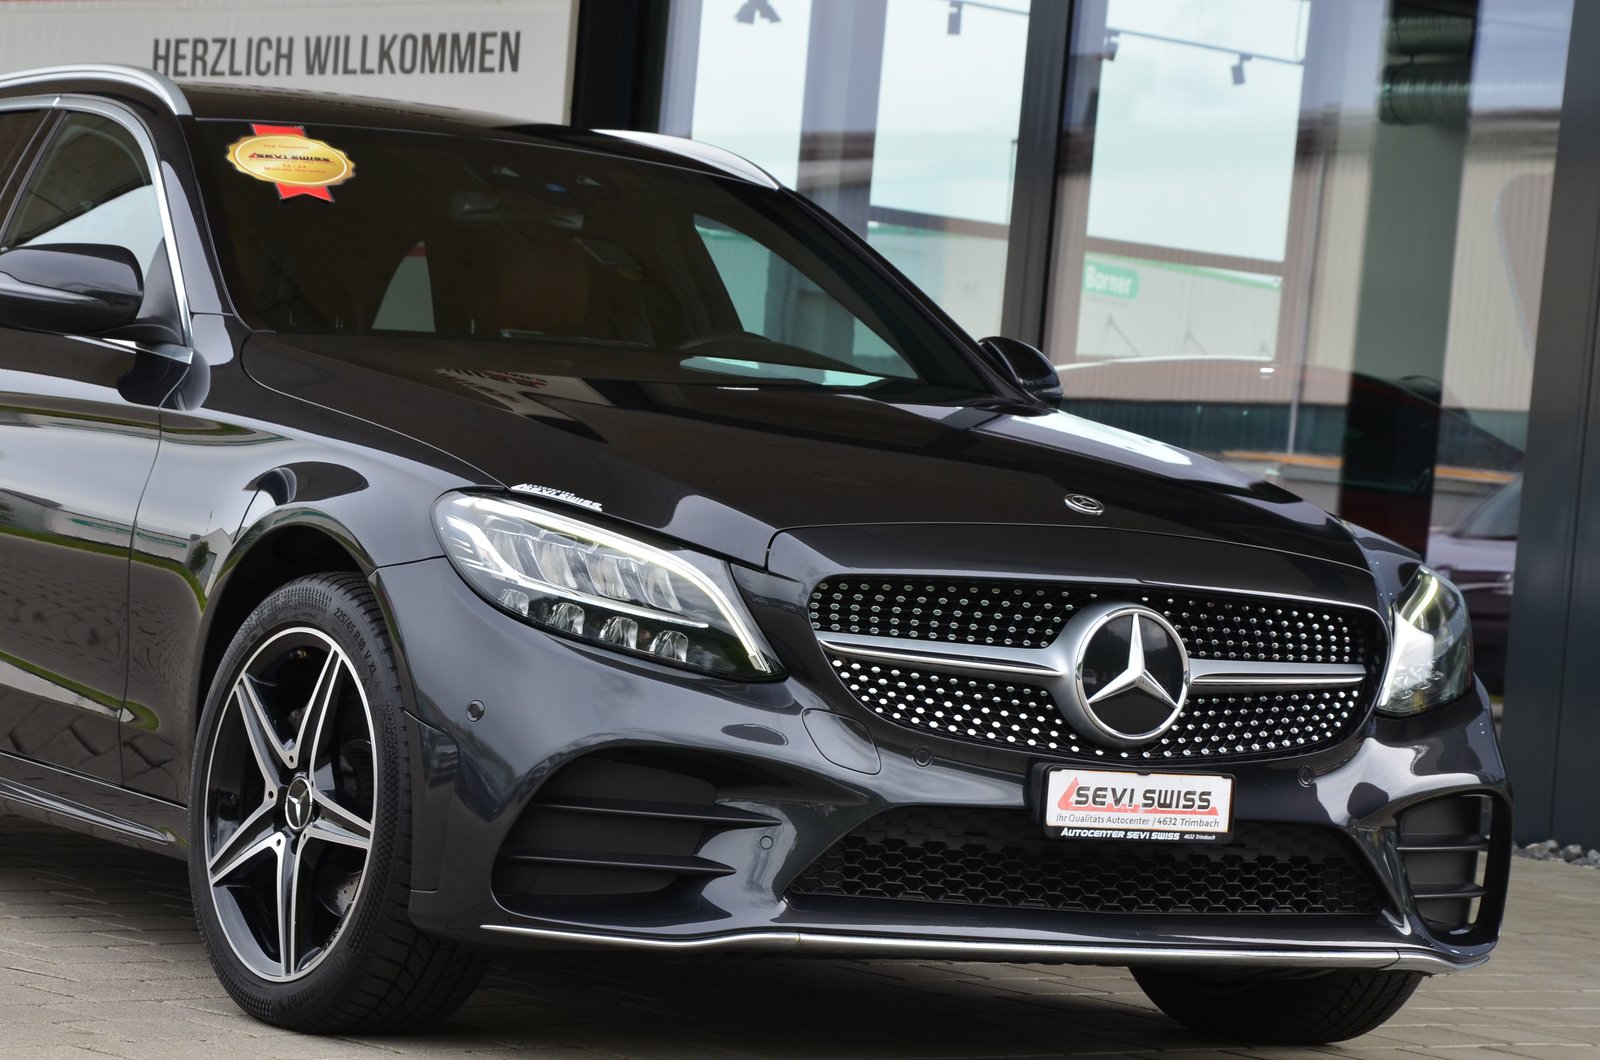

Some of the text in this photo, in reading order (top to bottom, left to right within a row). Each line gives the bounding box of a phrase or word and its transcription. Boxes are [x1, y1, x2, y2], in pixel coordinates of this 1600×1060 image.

[152, 31, 521, 78] HERZLICH WILLKOMMEN
[333, 607, 356, 634] 225/45
[1074, 786, 1212, 810] SEVI SWISS
[1056, 813, 1068, 822] Ihr
[1106, 815, 1150, 826] Autocenter
[1180, 818, 1220, 828] Trimbach
[1126, 831, 1150, 840] SEVI
[1150, 832, 1181, 840] SWISS
